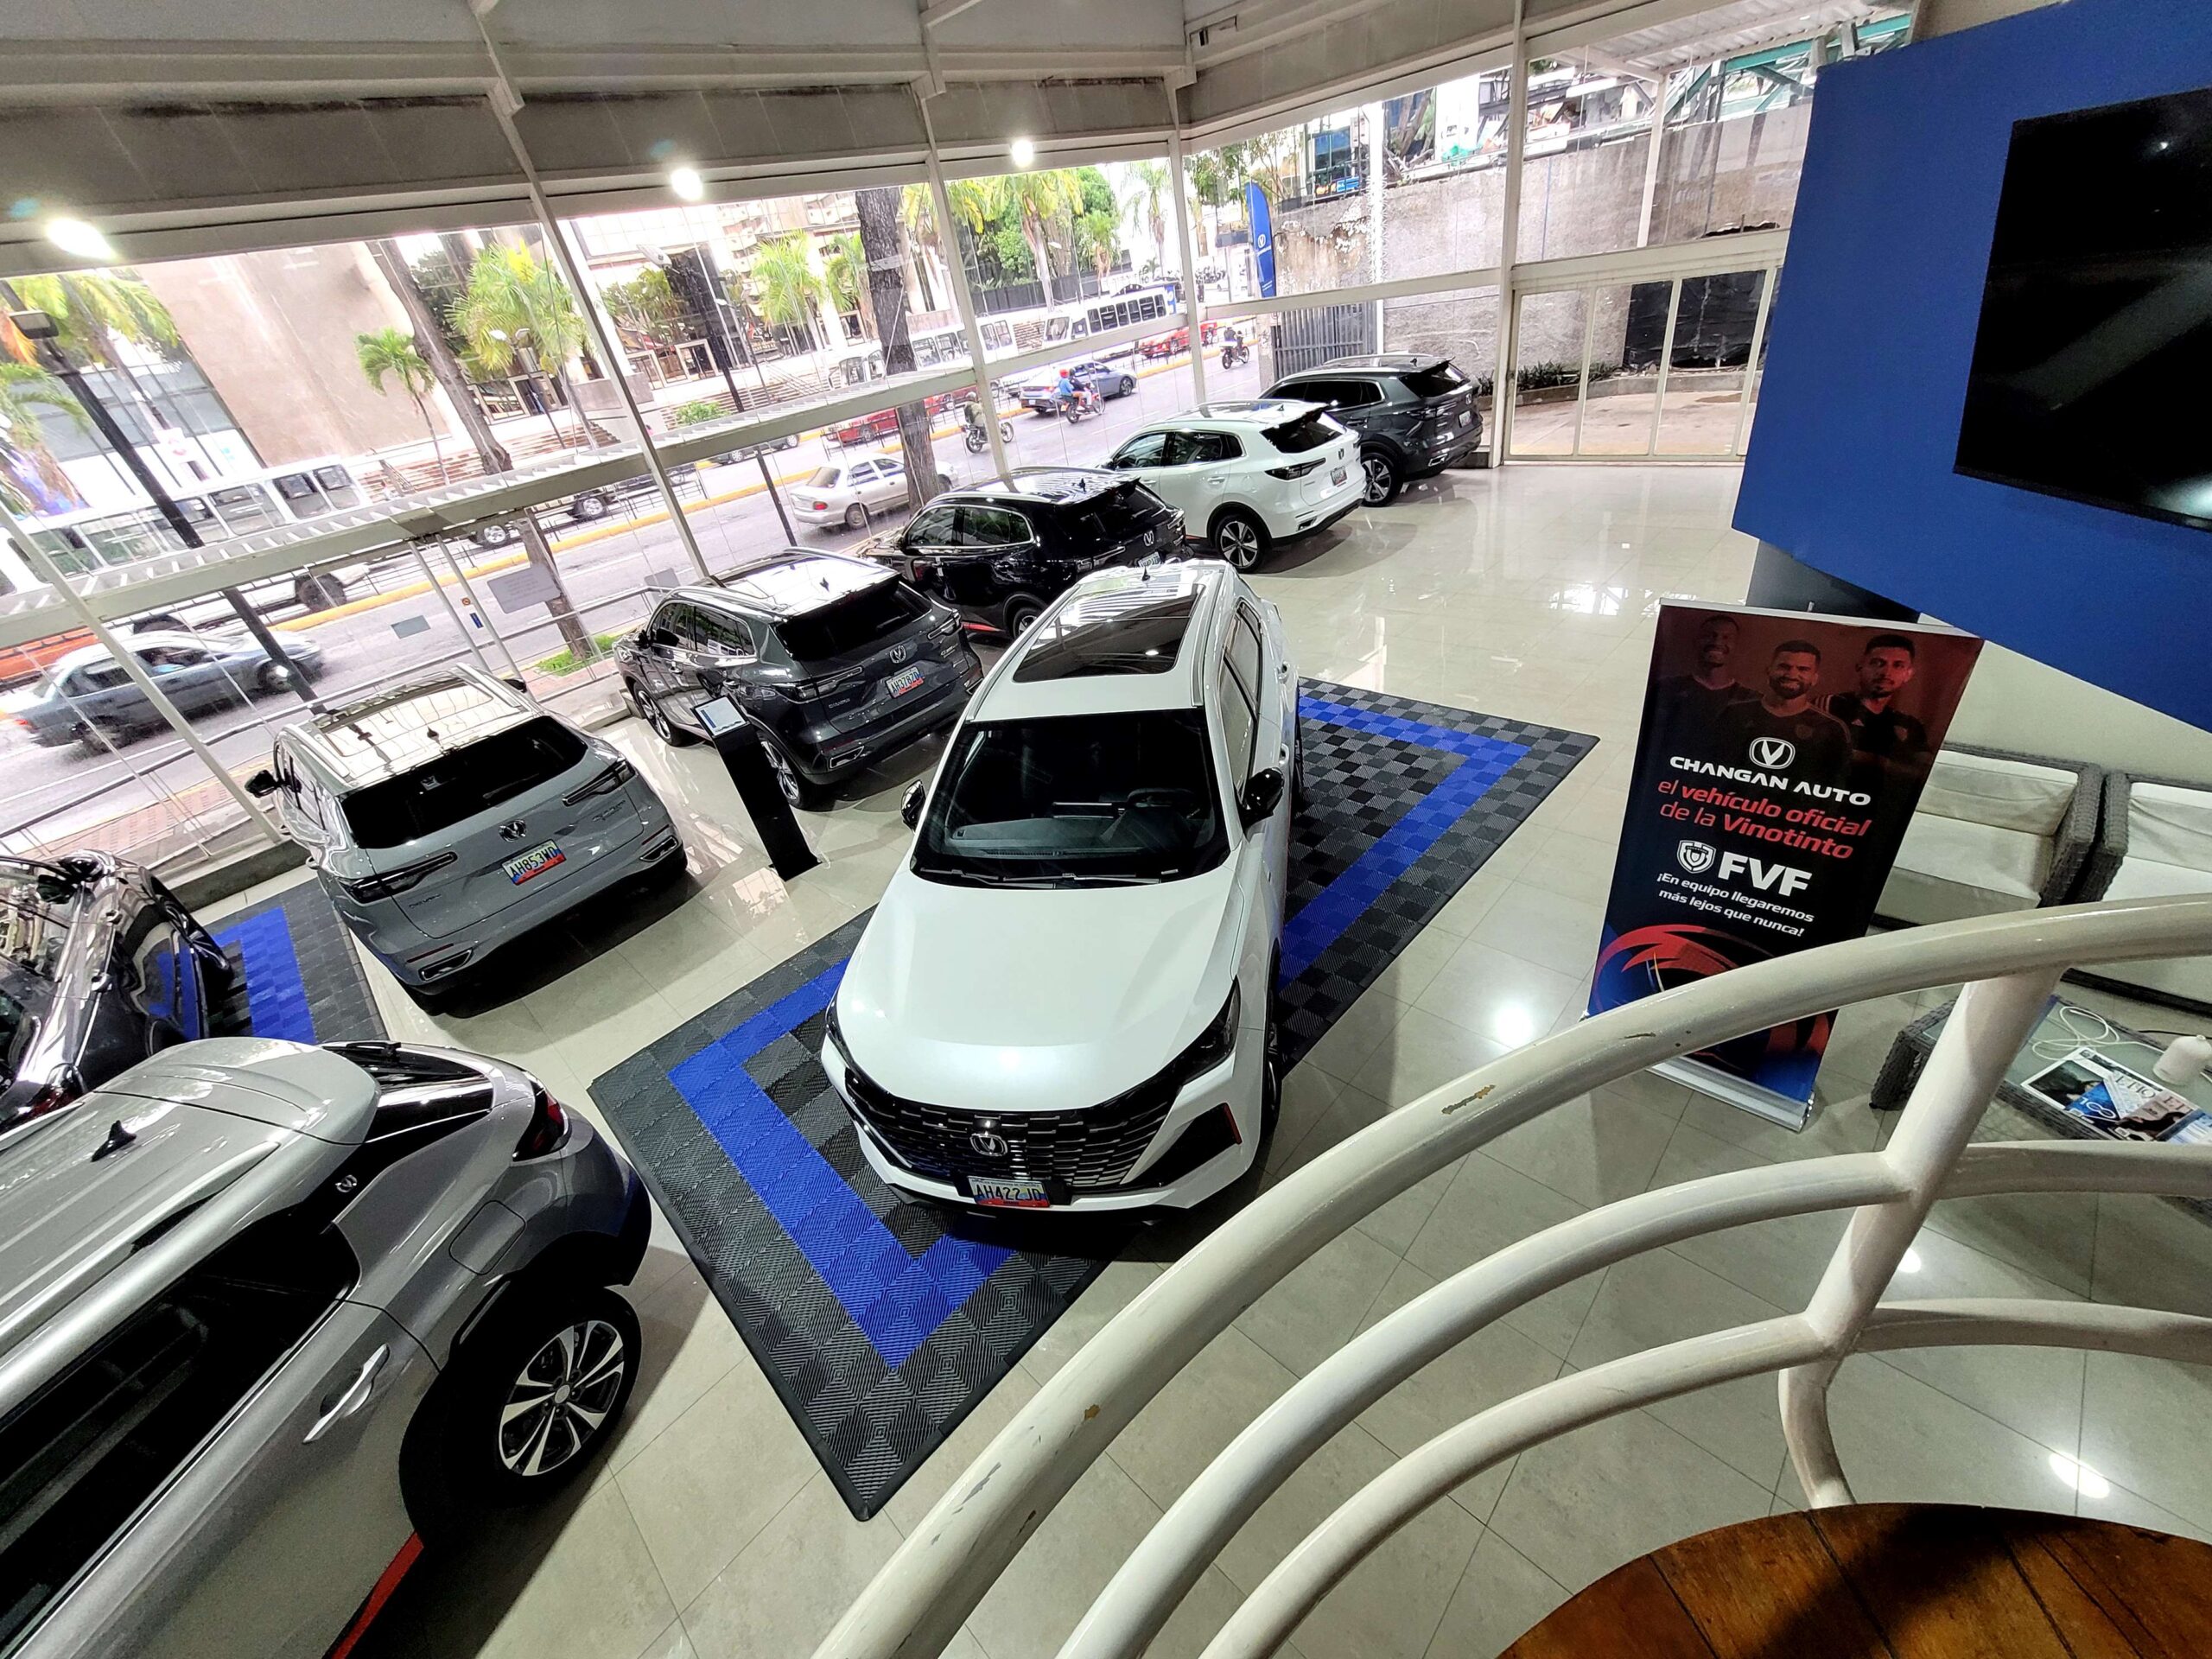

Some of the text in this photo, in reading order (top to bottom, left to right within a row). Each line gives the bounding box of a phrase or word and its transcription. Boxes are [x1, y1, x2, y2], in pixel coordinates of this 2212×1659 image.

[890, 671, 921, 694] AH378ZD
[1669, 756, 1872, 806] CHANGAN AUTO
[1658, 779, 1872, 836] el vehículo oficial
[1660, 802, 1853, 859] de la Vinotinto
[509, 846, 558, 876] AH853WD
[1718, 851, 1813, 897] FVF
[1657, 873, 1815, 923] ¡En equipo llegaremos
[1659, 889, 1805, 938] más lejos que nunca!
[976, 1184, 1042, 1202] AH422JD
